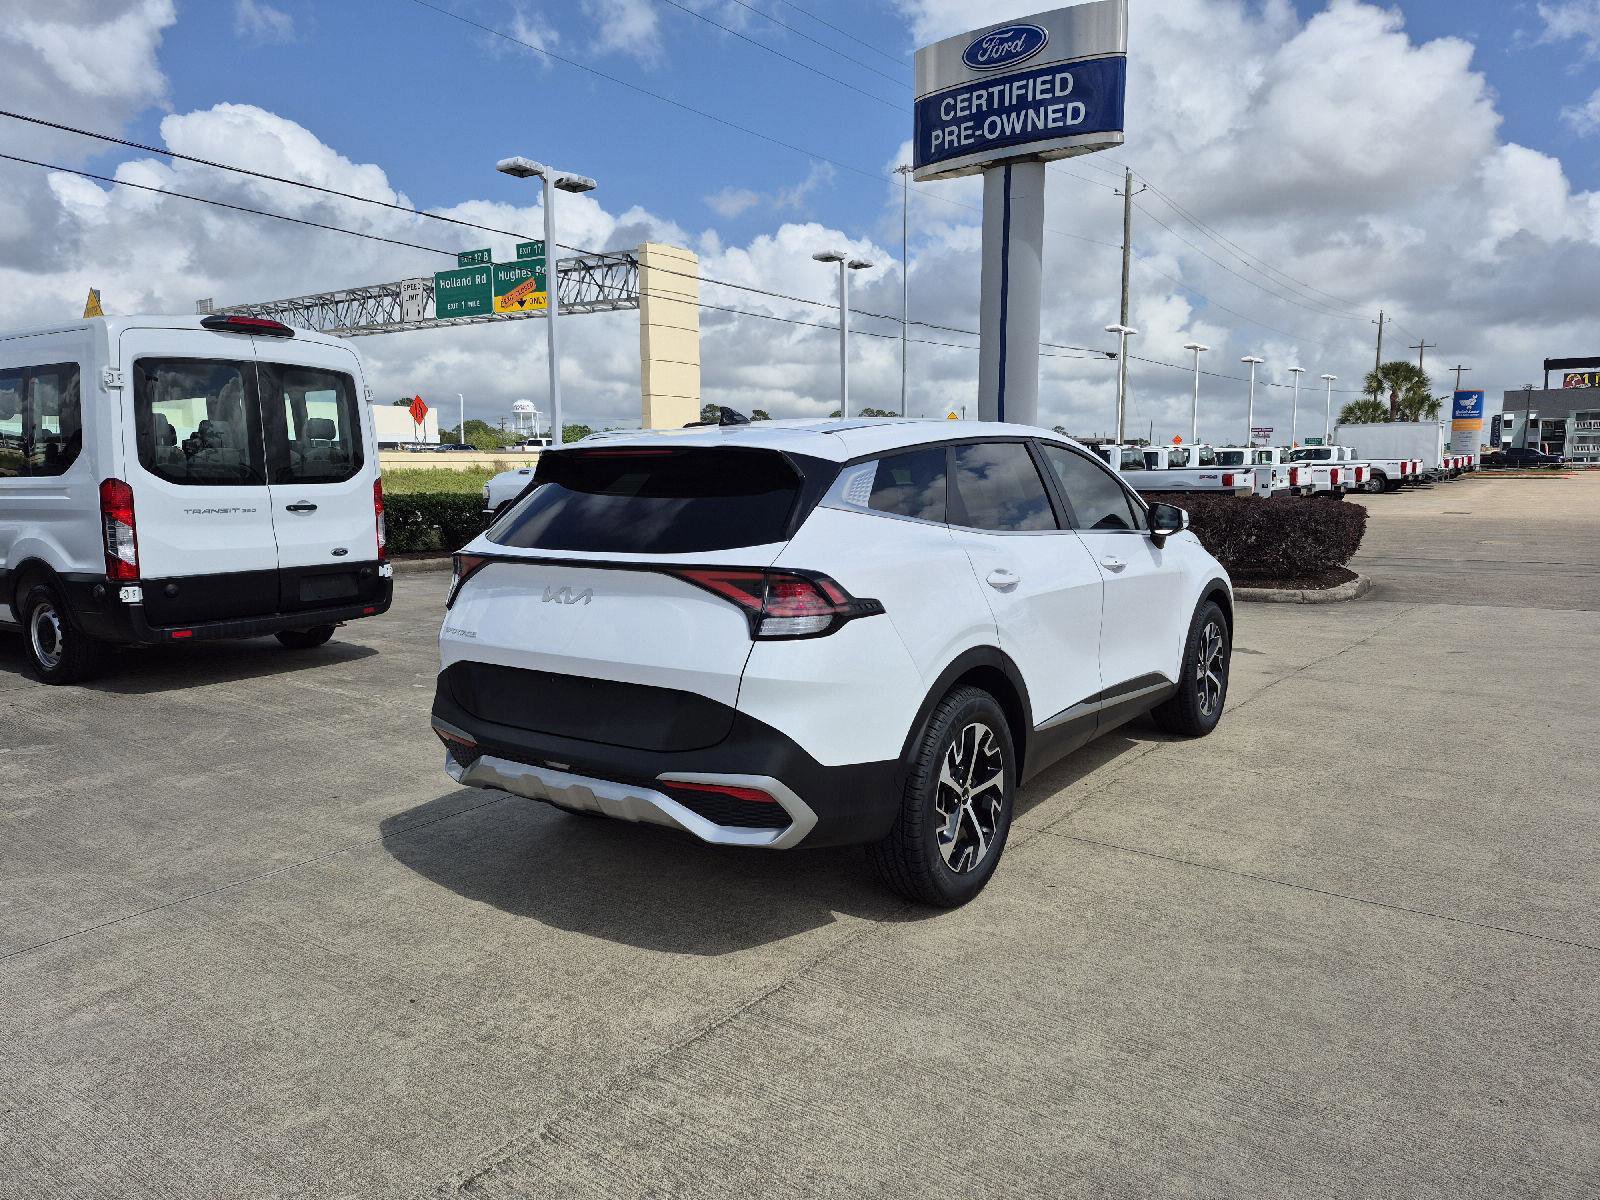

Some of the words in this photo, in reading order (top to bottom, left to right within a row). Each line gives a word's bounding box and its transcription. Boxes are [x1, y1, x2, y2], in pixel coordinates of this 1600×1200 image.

[977, 31, 1027, 62] Ford
[940, 72, 1074, 121] CERTIFIED
[931, 101, 1086, 153] PRE-OWNED
[519, 246, 532, 255] EXIT
[533, 243, 543, 254] 17
[483, 251, 489, 261] B
[498, 268, 532, 282] Hughes
[440, 277, 472, 289] Holland
[475, 273, 487, 285] Rd
[402, 282, 421, 292] SPEED
[406, 293, 420, 302] LIMIT
[529, 296, 547, 305] ONLY
[447, 302, 459, 310] EXIT
[461, 300, 465, 310] 1
[467, 299, 481, 308] MILE
[183, 507, 240, 516] TRANSIT
